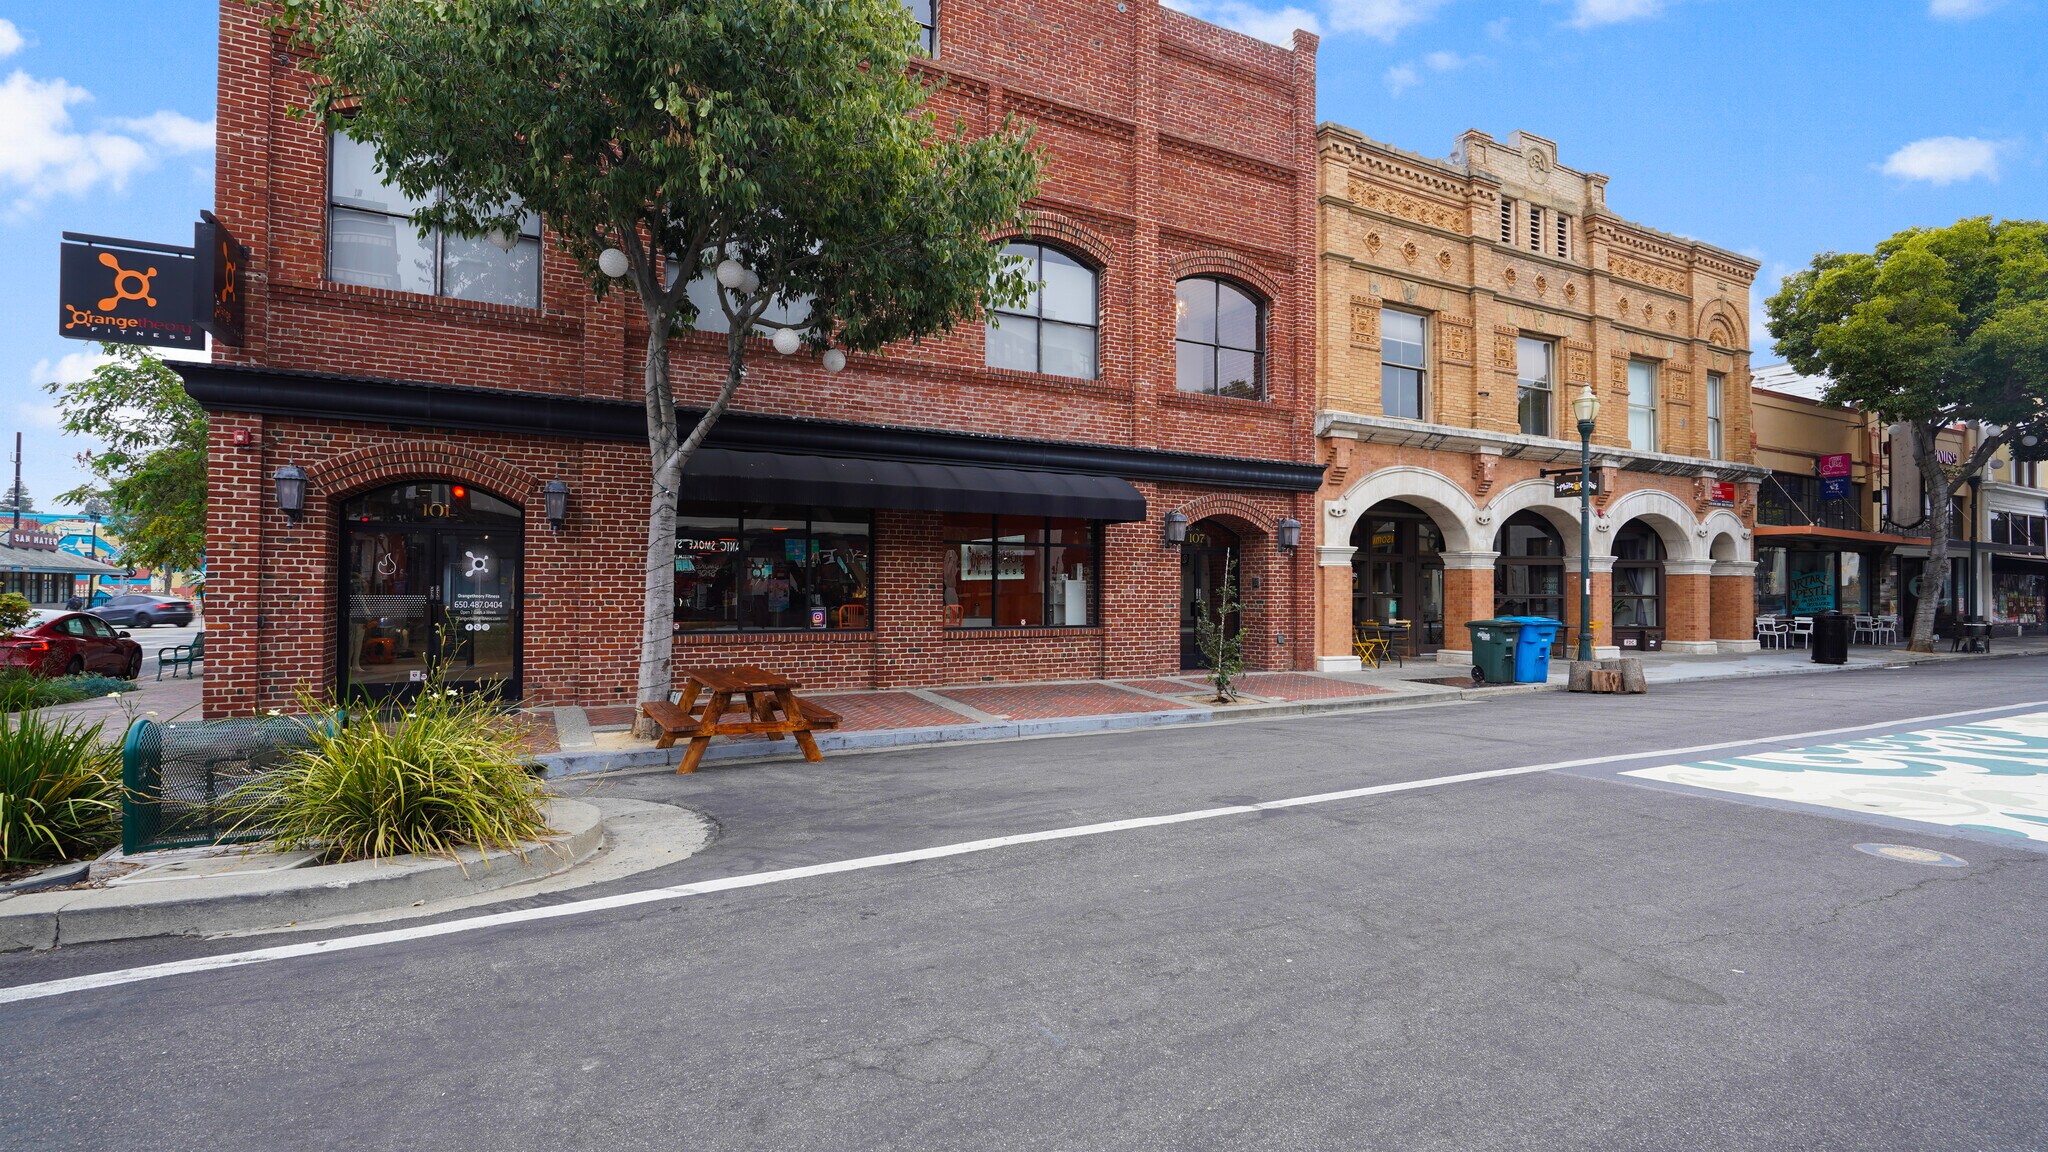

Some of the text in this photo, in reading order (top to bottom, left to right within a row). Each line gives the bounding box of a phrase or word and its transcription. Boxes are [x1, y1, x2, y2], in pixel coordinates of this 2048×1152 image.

[91, 326, 191, 341] FITNESS
[14, 534, 58, 546] SAN MATEO
[1190, 533, 1205, 543] 107
[977, 568, 1025, 576] FINESS
[1796, 585, 1832, 599] PESTLE
[454, 600, 503, 609] 650.487.0404
